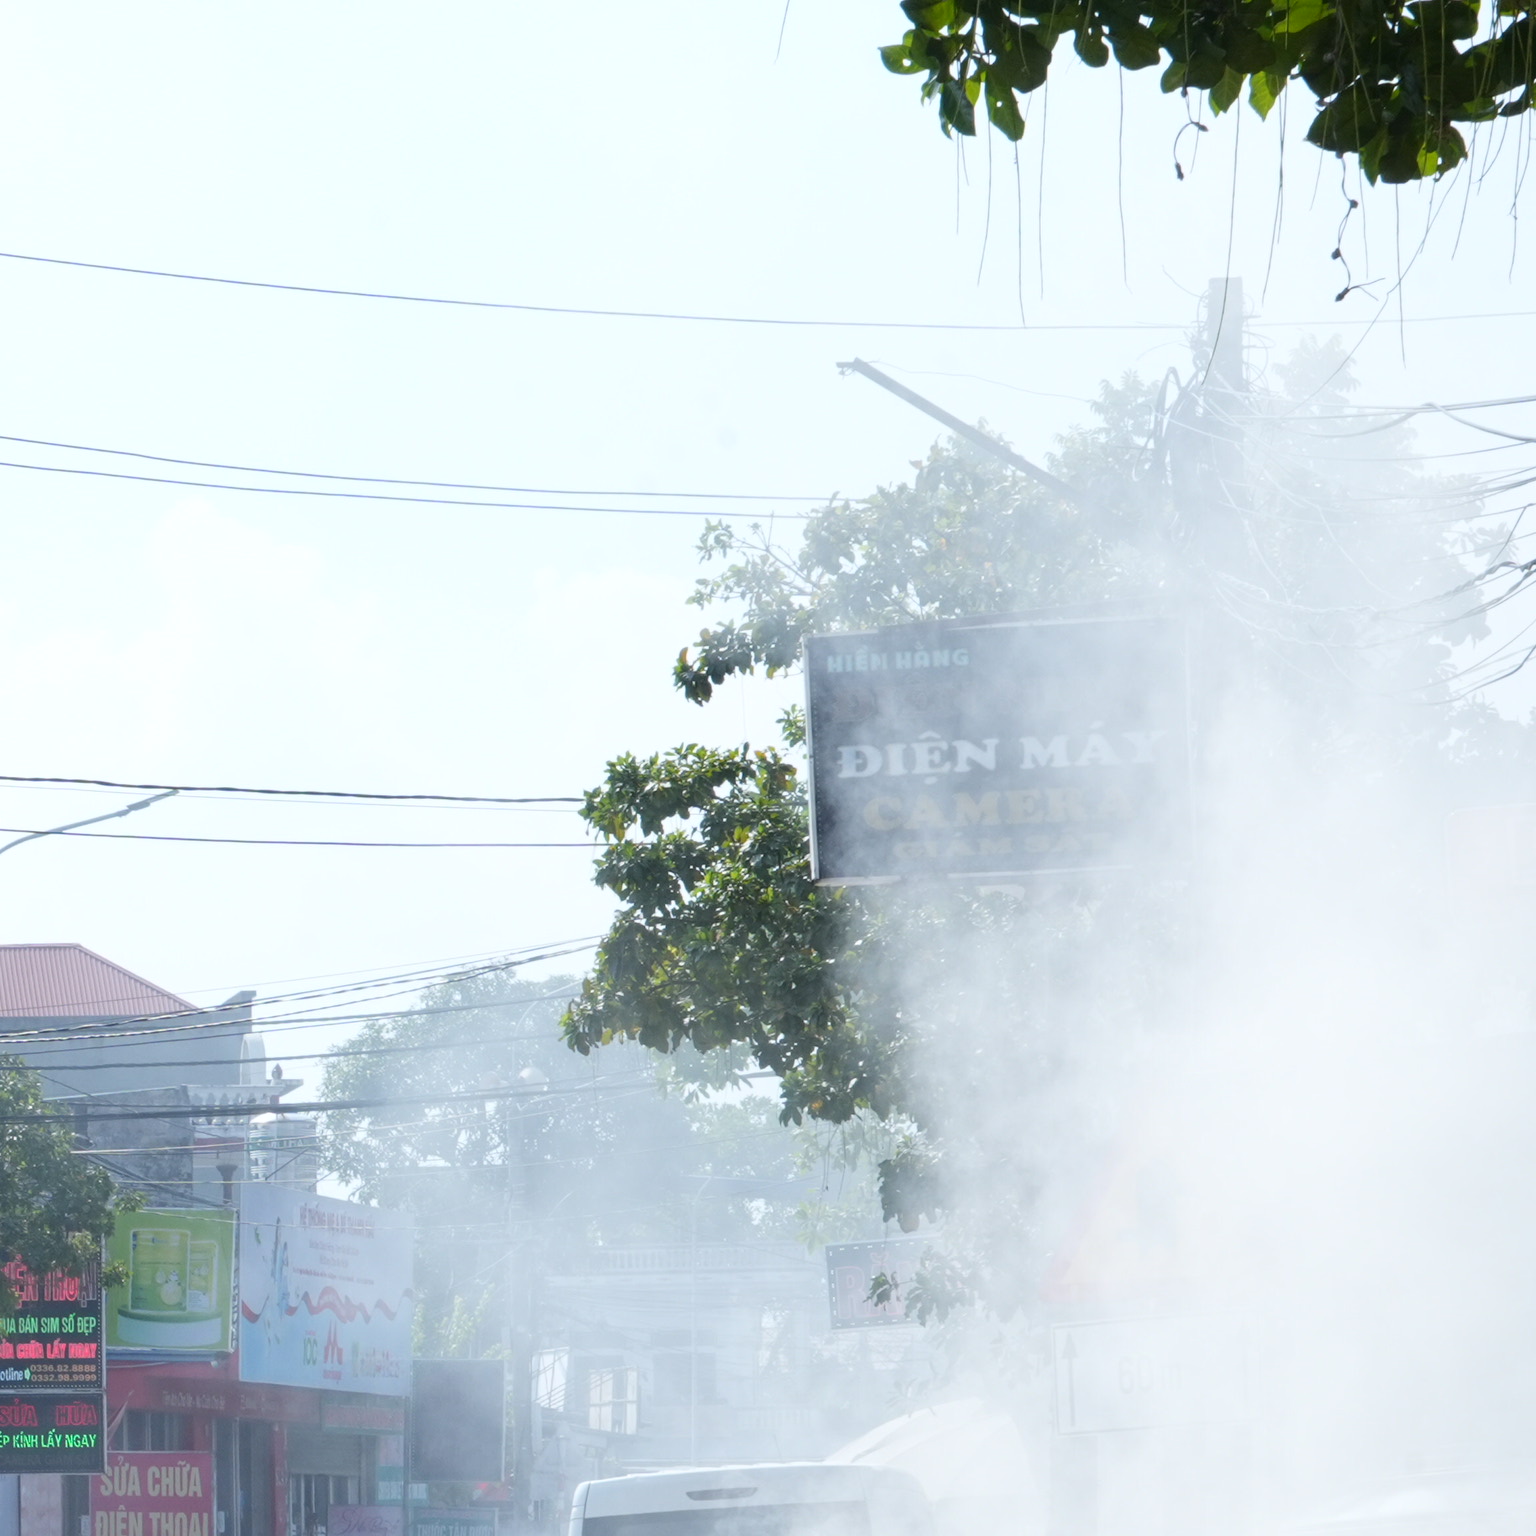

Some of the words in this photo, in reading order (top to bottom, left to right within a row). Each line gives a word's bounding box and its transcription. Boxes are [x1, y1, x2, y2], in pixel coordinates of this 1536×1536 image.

[837, 731, 998, 785] ĐIỆN
[1019, 721, 1167, 770] MÁY
[19, 1315, 38, 1334] BÁN
[40, 1317, 59, 1334] SIM
[62, 1313, 76, 1334] SỐ
[77, 1317, 96, 1336] ĐẸP
[47, 1338, 66, 1359] LẤY
[68, 1343, 97, 1359] NGAY
[56, 1401, 98, 1426] HỮA
[13, 1431, 38, 1448] KÍNH
[41, 1428, 62, 1448] LẤY
[65, 1434, 97, 1448] NGAY
[100, 1455, 142, 1497] SỬA
[147, 1460, 203, 1498] CHỮA
